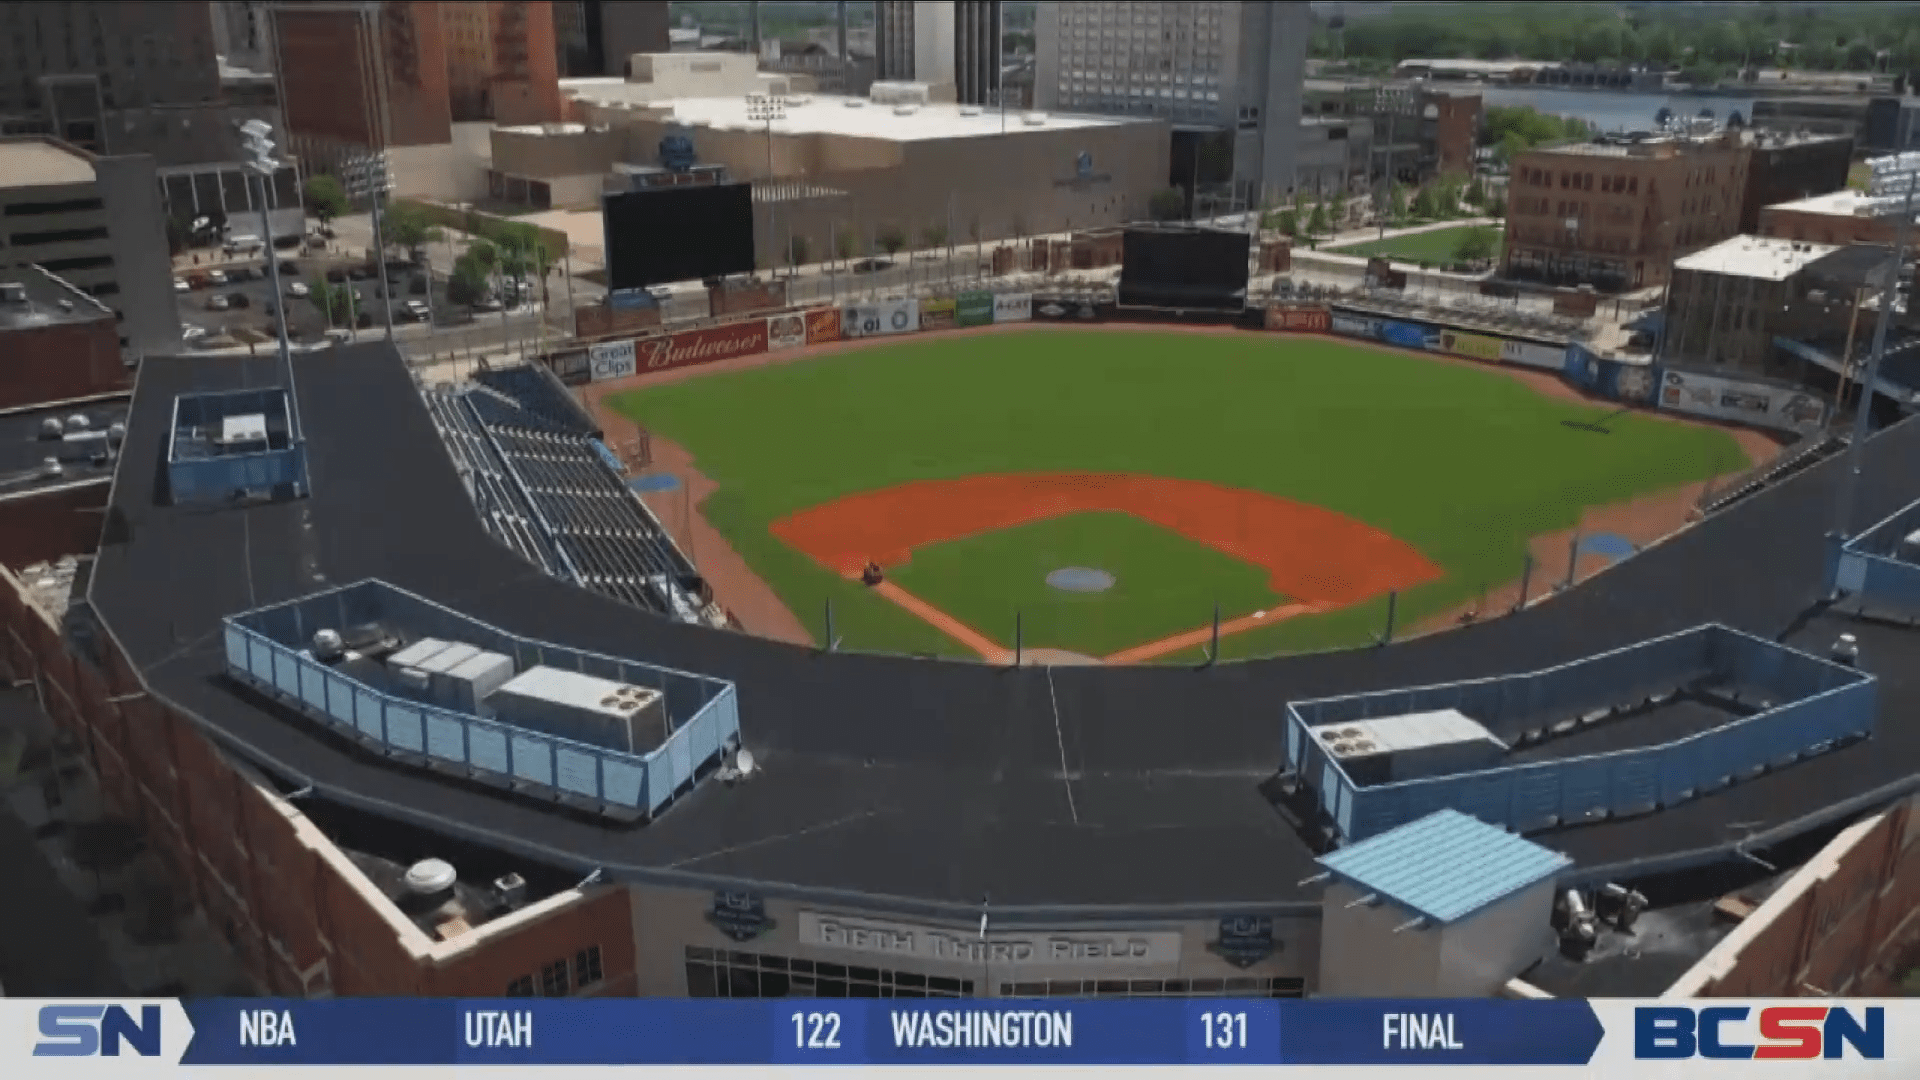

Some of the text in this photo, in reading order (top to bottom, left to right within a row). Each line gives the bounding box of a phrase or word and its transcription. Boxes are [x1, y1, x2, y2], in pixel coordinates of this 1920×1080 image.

[590, 344, 633, 361] Great
[642, 333, 762, 368] Budweiser
[594, 359, 632, 377] Clips
[819, 921, 1151, 962] FIFTH THIRD FIELD
